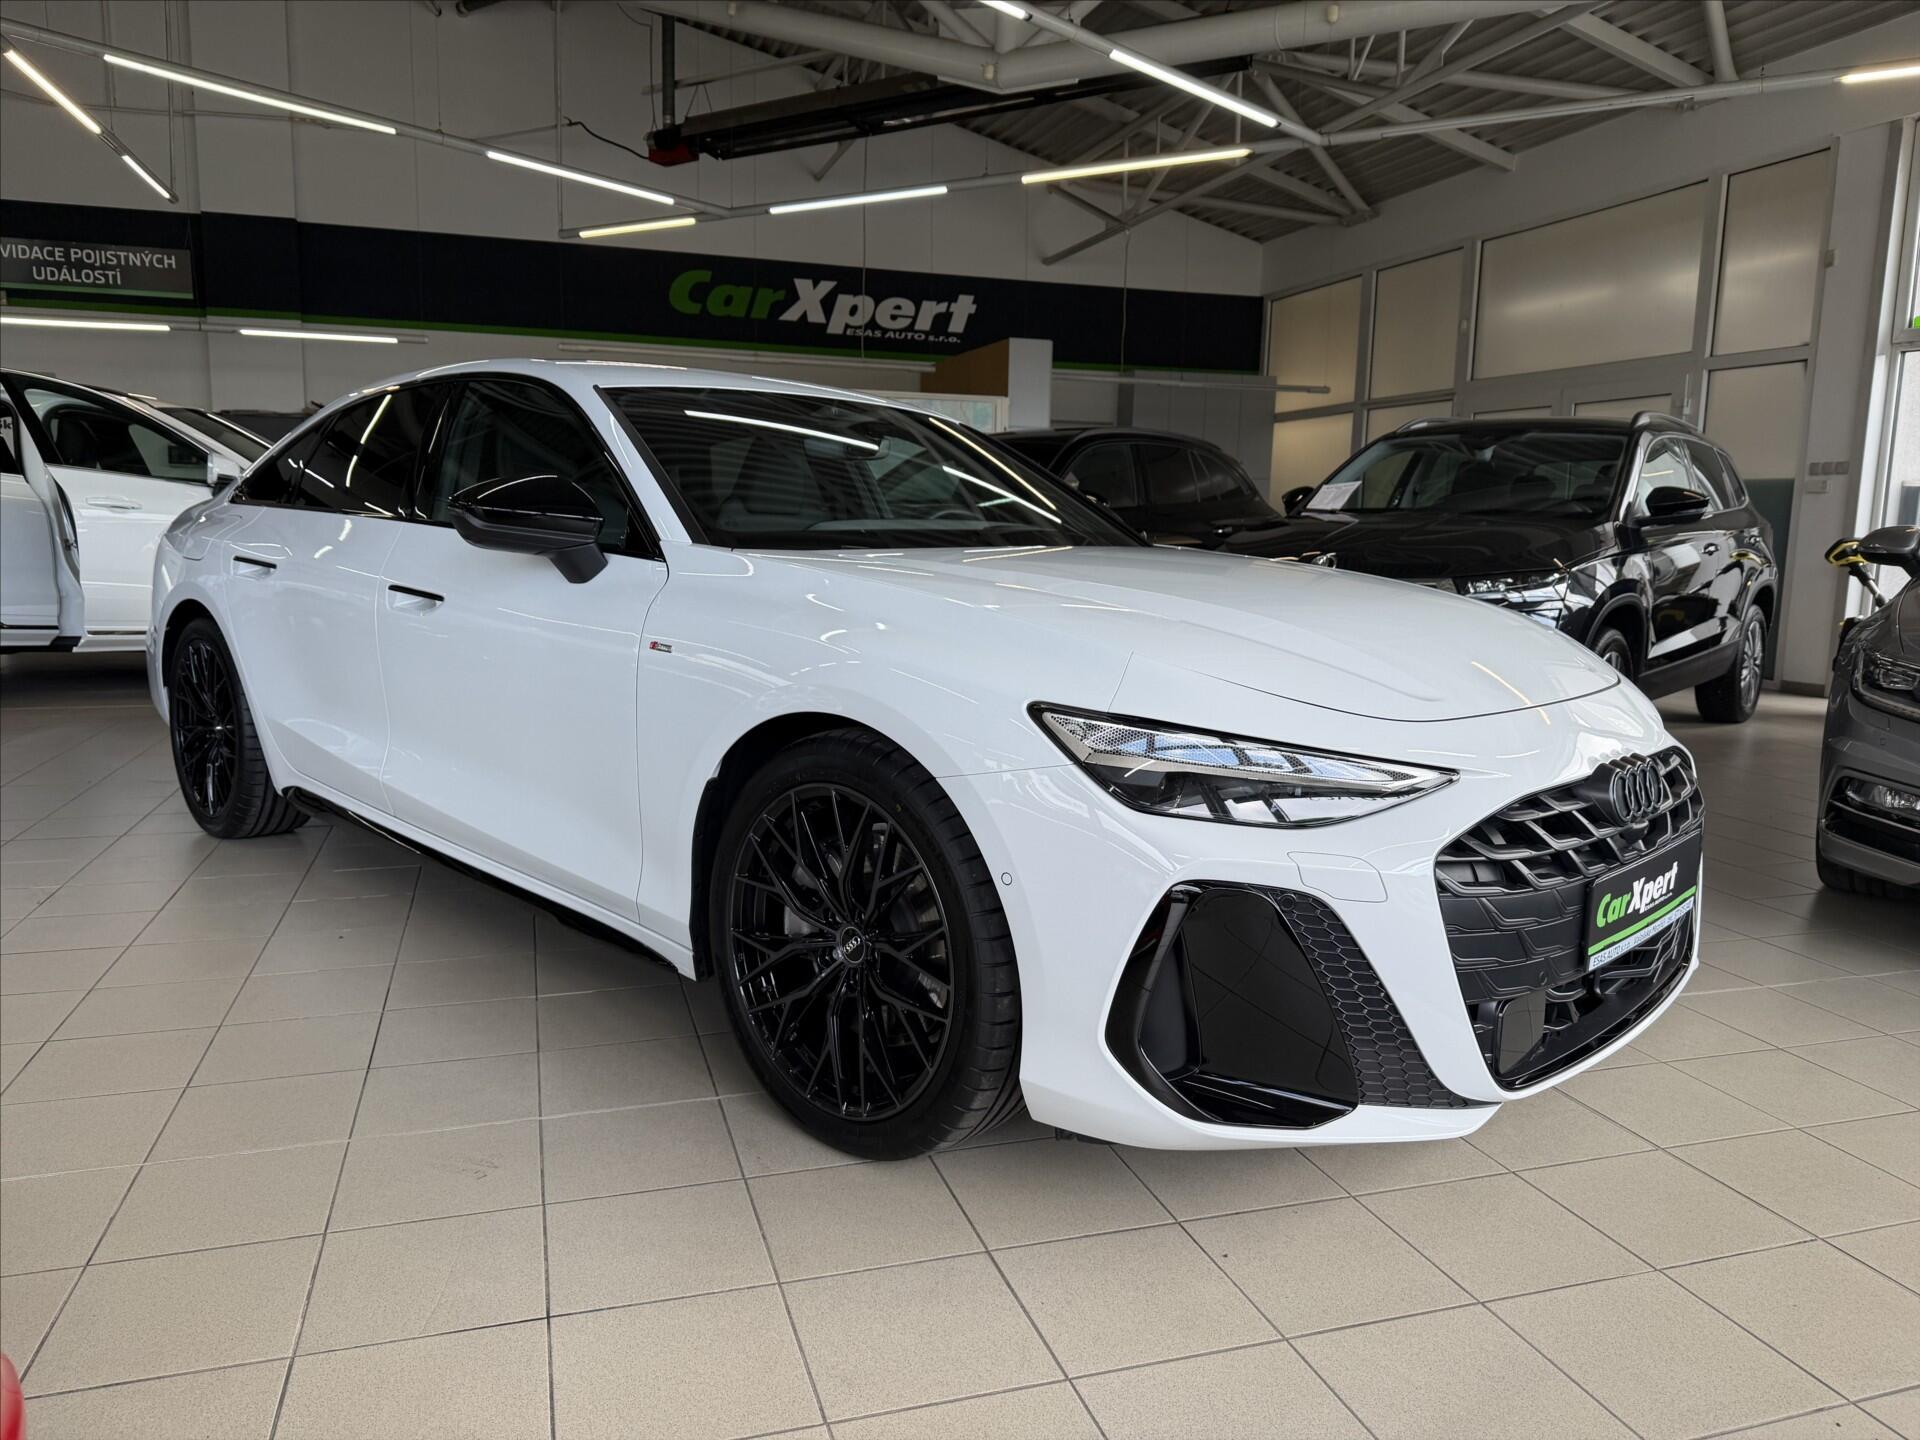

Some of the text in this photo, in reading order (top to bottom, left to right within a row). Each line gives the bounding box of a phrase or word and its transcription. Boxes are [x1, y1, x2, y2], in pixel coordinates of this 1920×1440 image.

[70, 248, 177, 269] POJISTNÝCH
[32, 265, 122, 285] UDÁLOSTÍ
[668, 268, 977, 335] CarXpert
[846, 328, 960, 343] ESAS AUTO s.r.o.
[1596, 861, 1678, 928] CarXpert
